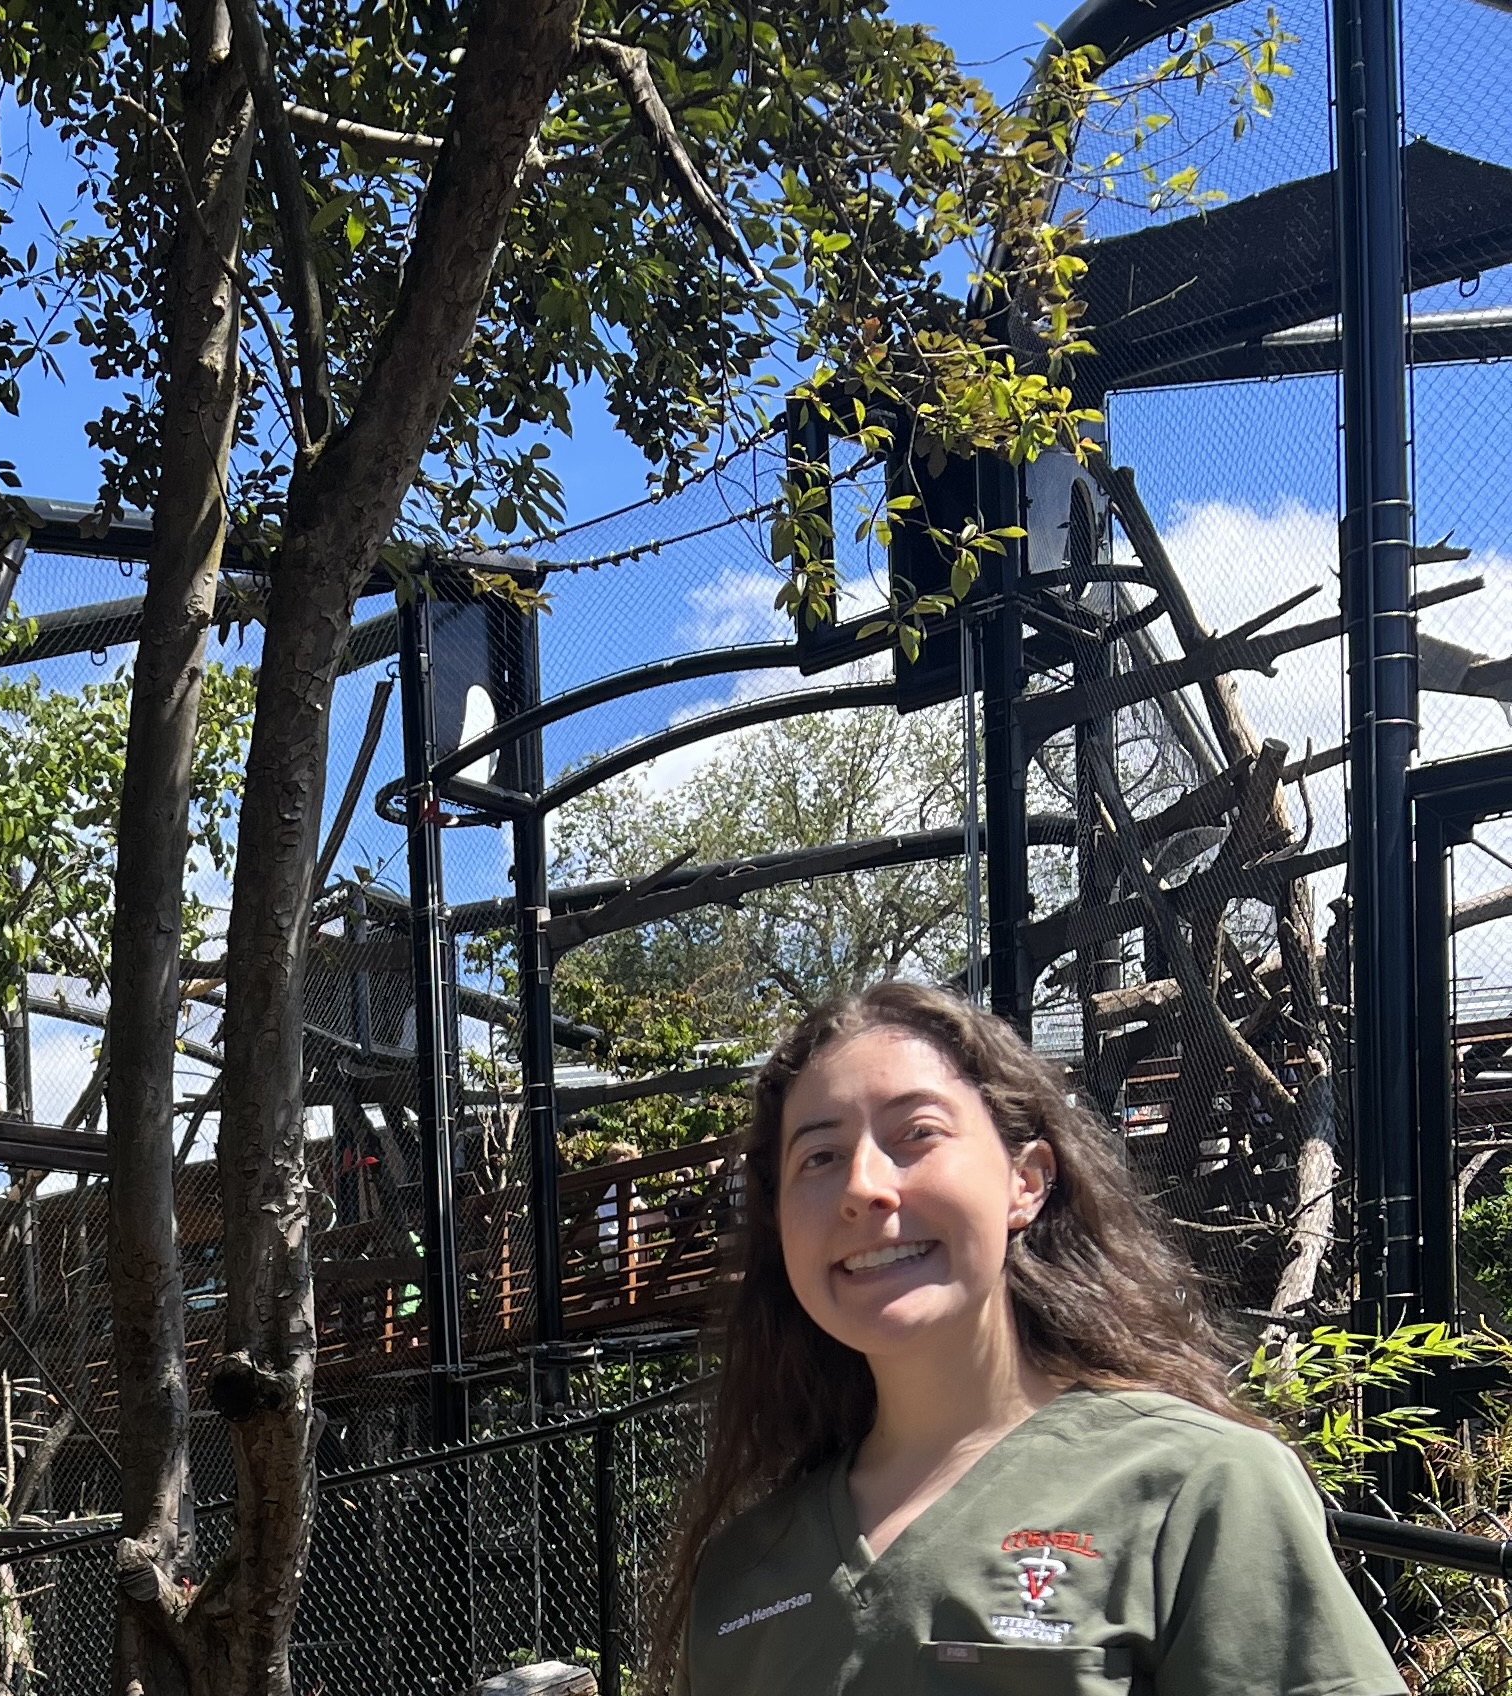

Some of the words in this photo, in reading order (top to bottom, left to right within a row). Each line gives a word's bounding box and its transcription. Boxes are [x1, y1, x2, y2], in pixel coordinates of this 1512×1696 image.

[1000, 1529, 1105, 1559] CORNELL
[718, 1613, 750, 1636] Sarah
[751, 1592, 813, 1624] Henderson
